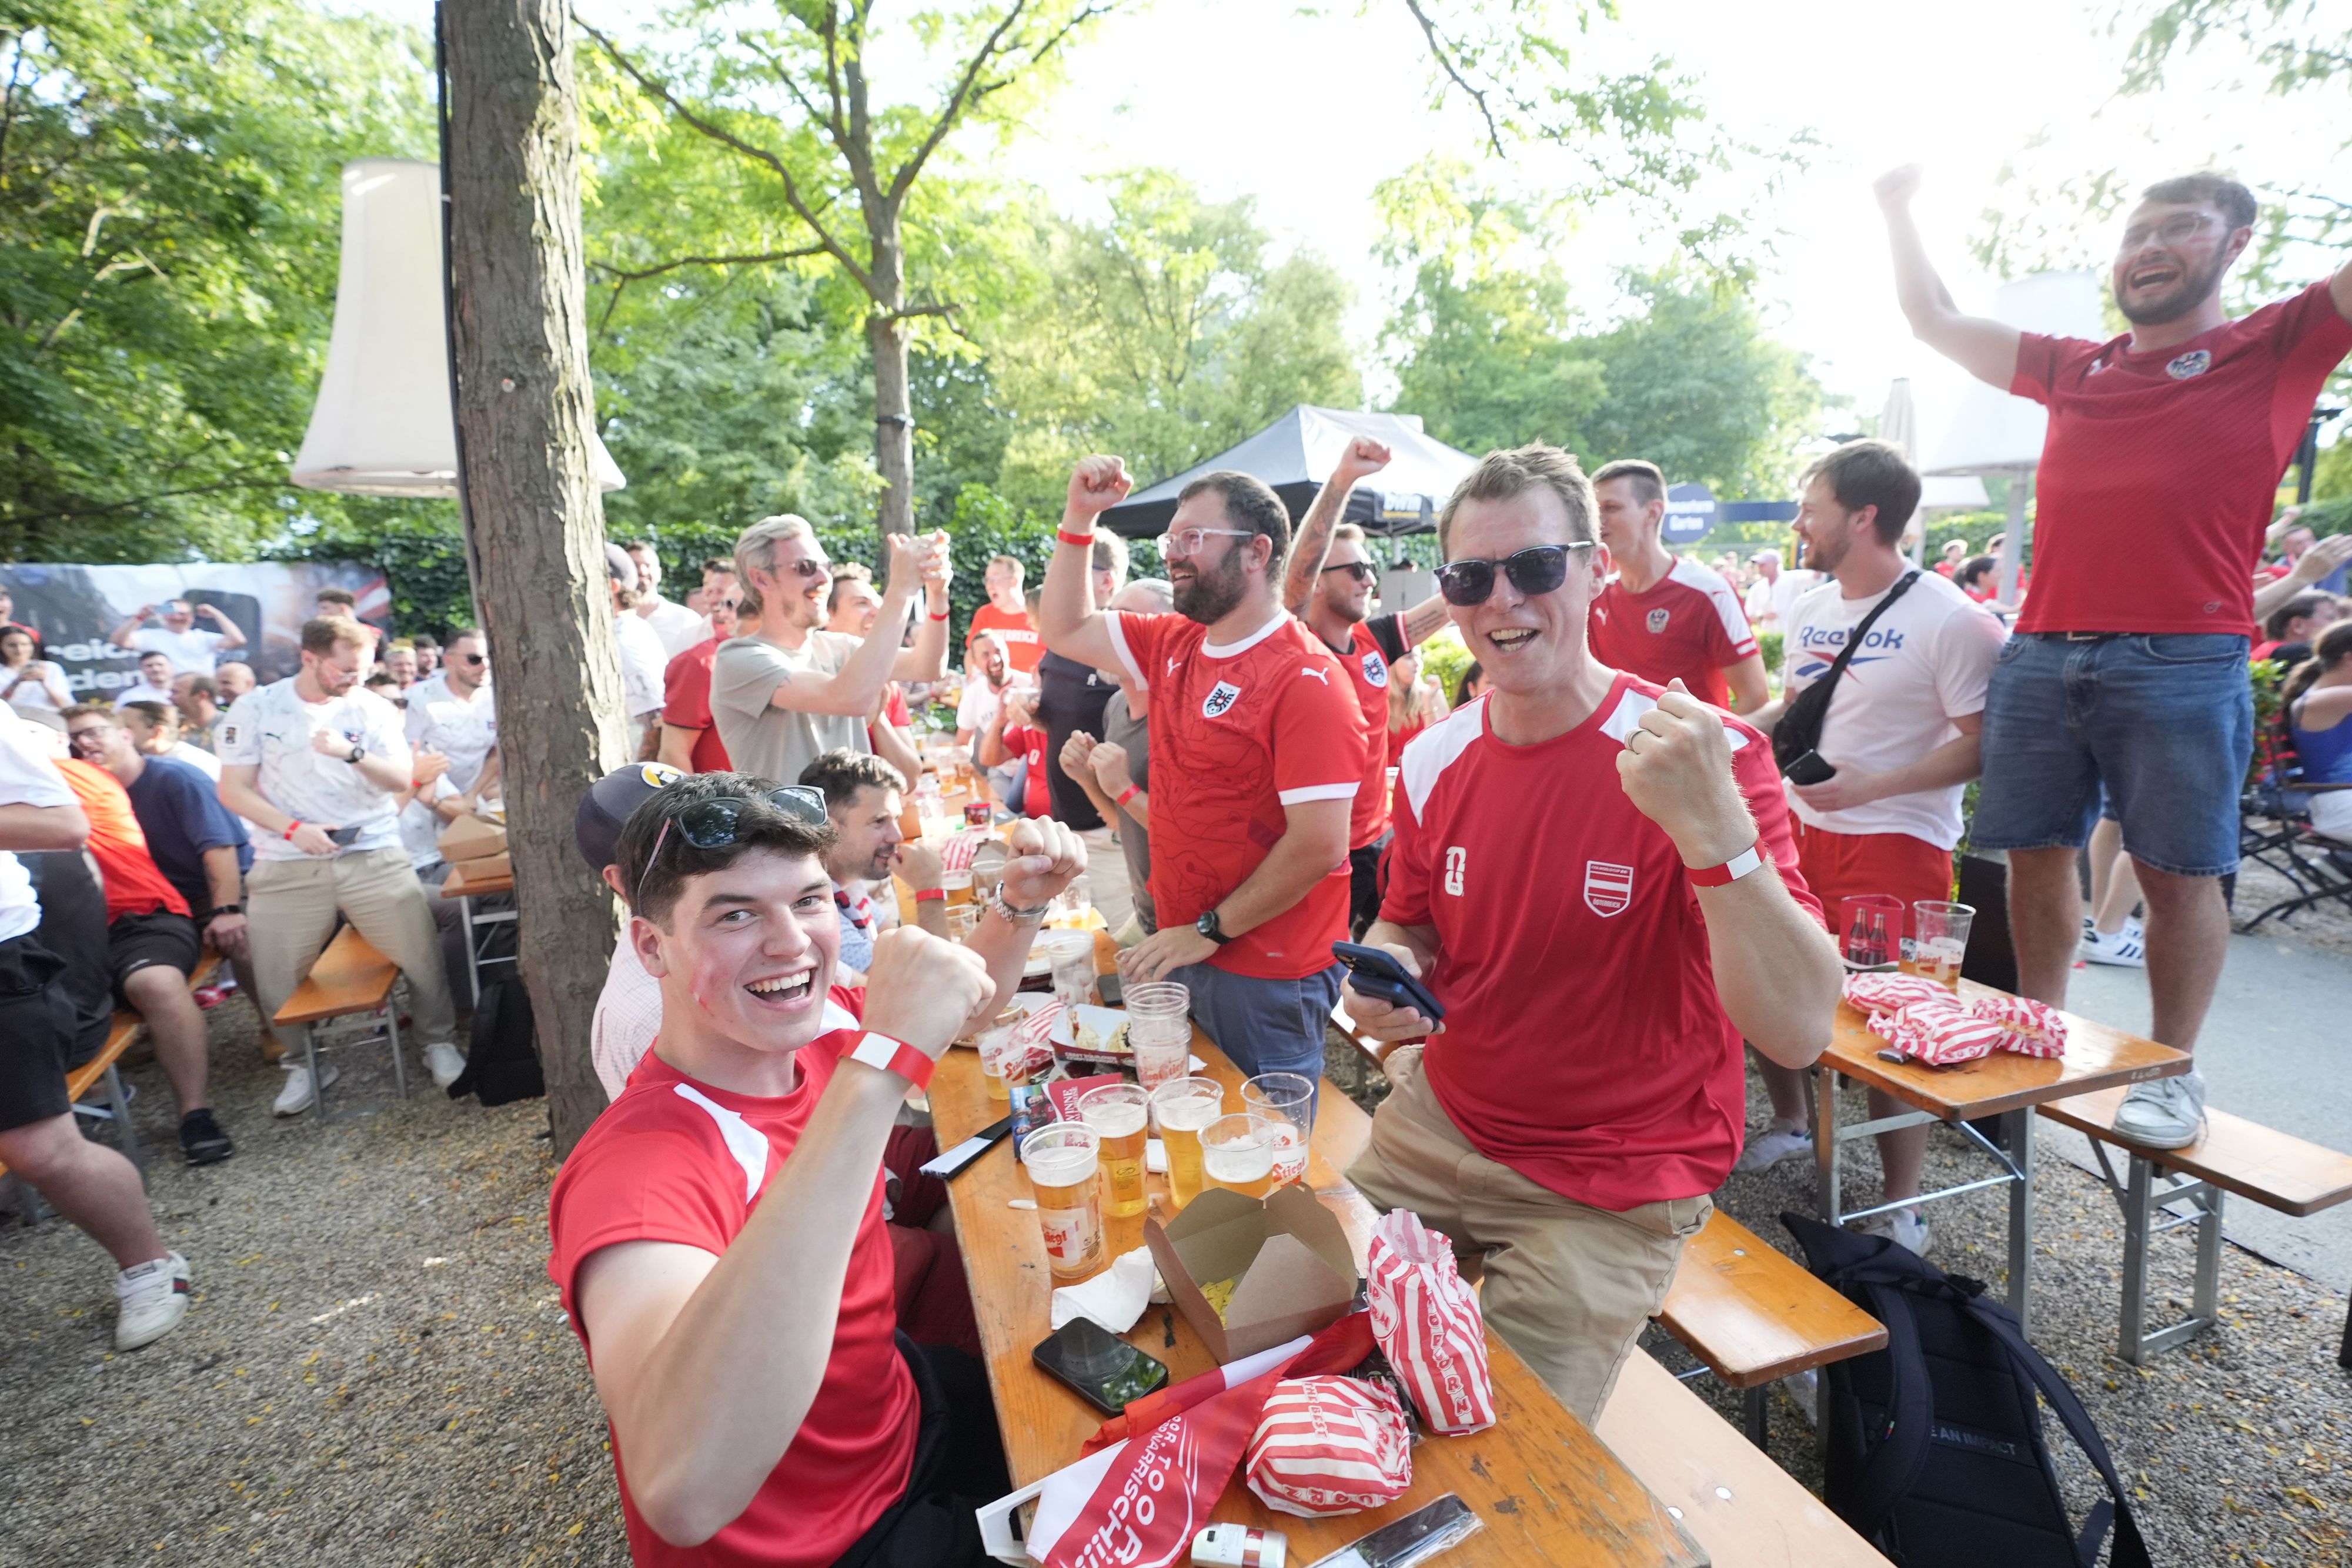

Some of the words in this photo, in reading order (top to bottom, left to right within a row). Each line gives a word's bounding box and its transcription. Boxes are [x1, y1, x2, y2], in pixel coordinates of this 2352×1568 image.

[1272, 1156, 1305, 1183] Stiegl
[1302, 1382, 1319, 1403] THE
[1308, 1405, 1329, 1440] BEST
